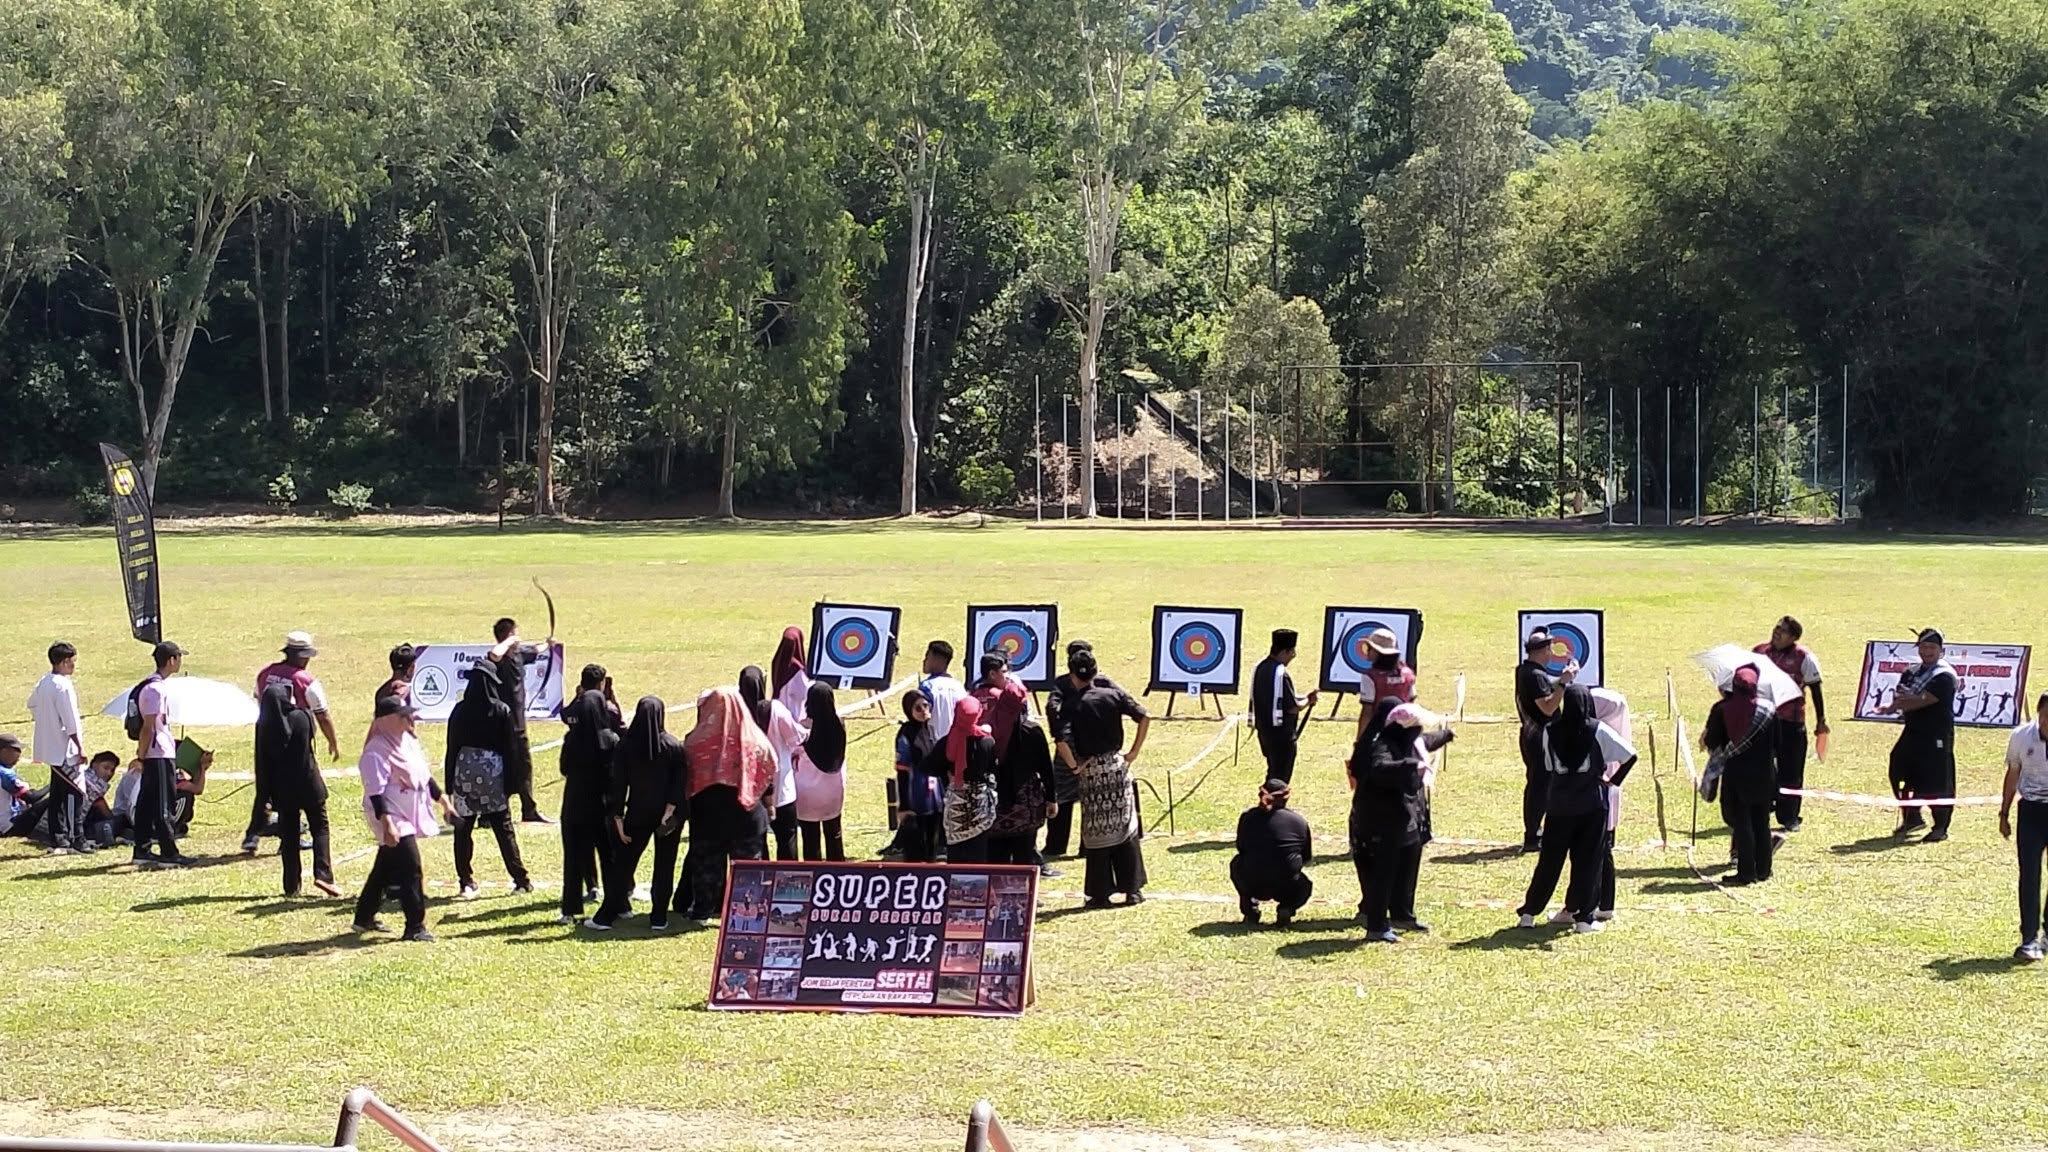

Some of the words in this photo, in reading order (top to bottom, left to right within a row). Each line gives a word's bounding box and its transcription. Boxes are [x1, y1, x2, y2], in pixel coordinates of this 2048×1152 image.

[1191, 686, 1198, 695] 3
[812, 873, 947, 910] SUPER
[810, 908, 862, 923] SUKAN
[869, 909, 943, 925] PERETAK
